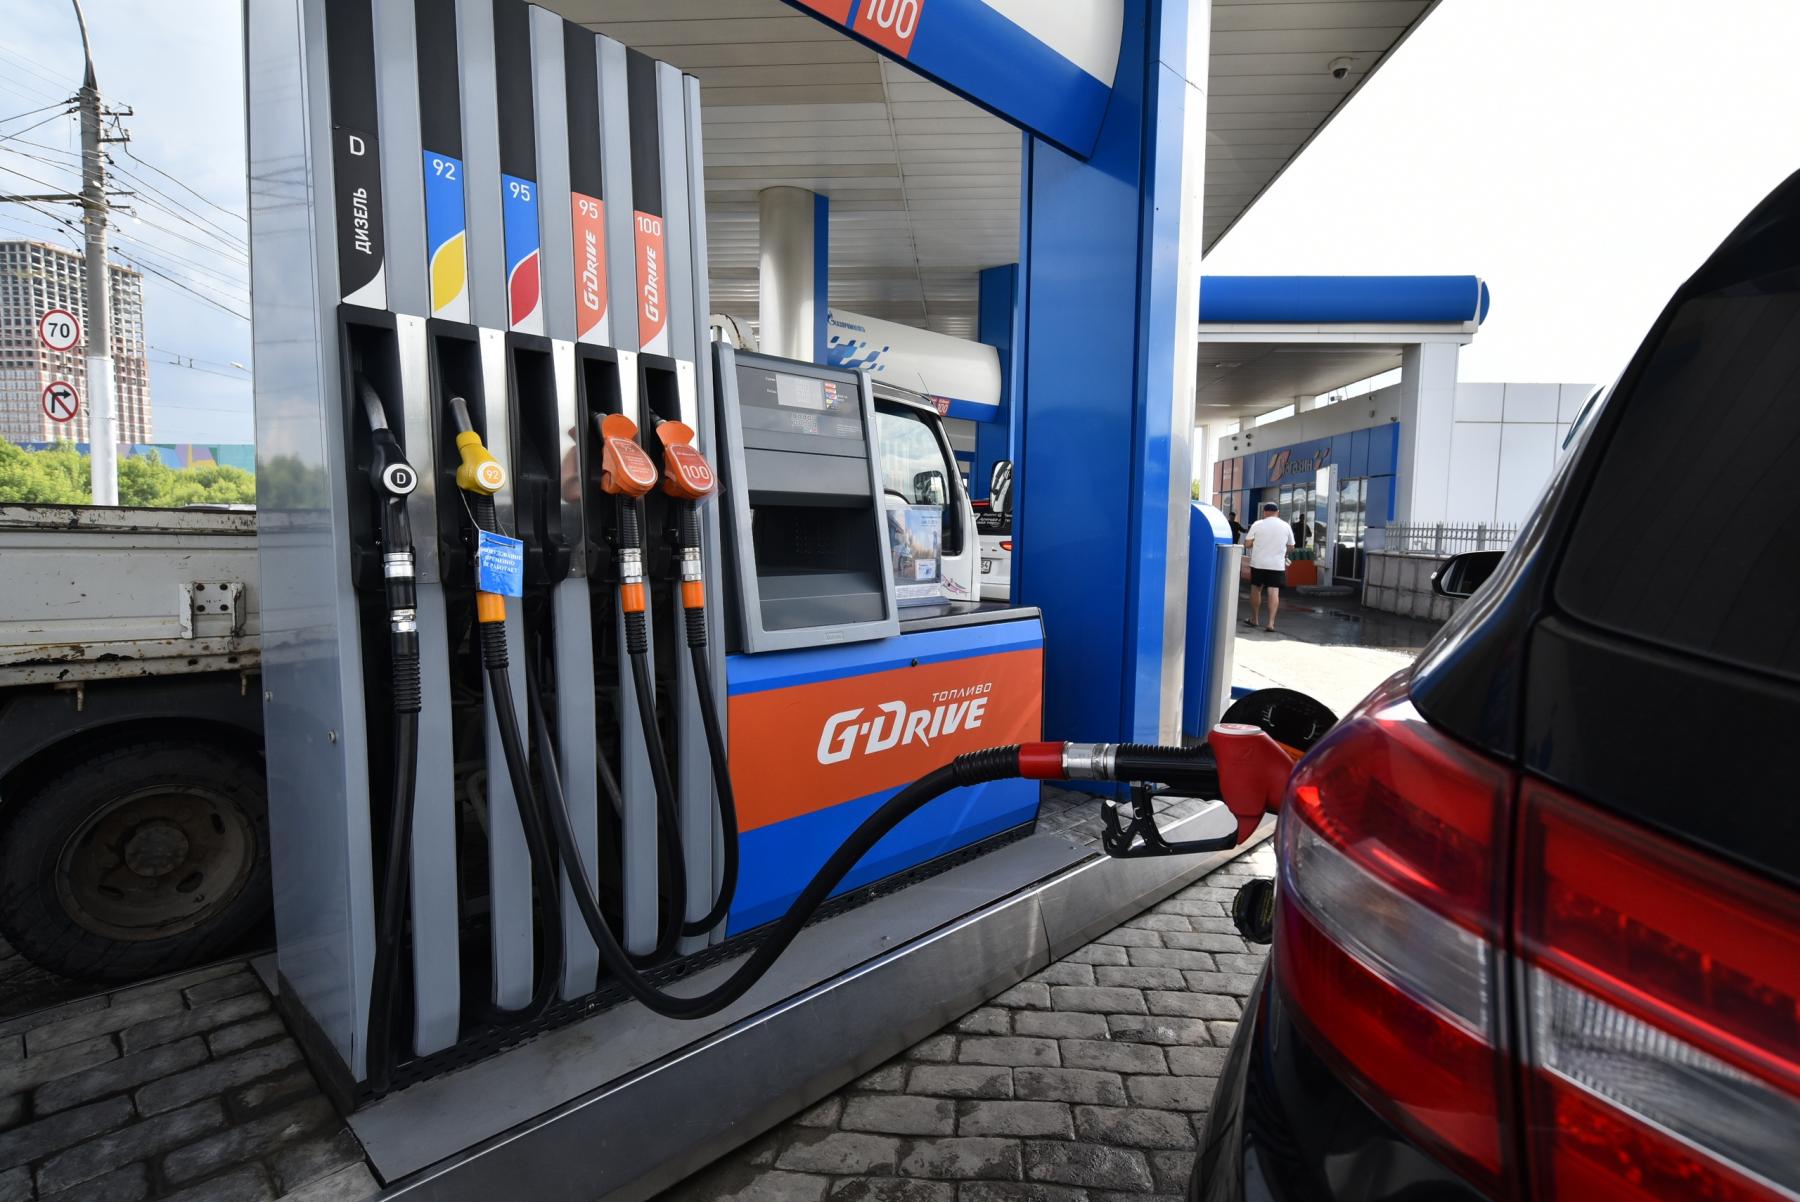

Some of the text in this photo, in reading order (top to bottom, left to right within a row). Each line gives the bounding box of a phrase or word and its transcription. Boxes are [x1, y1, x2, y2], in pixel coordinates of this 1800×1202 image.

[866, 0, 918, 39] 100
[349, 135, 365, 156] D
[432, 158, 456, 181] 92
[509, 181, 531, 202] 95
[578, 199, 599, 219] 95
[353, 187, 372, 254] ДИЗЕЛЬ
[637, 216, 661, 236] 100
[48, 322, 70, 338] 70
[396, 472, 406, 485] D
[486, 470, 499, 481] 92
[683, 464, 710, 480] 100
[932, 682, 993, 703] ТОПЛИВО
